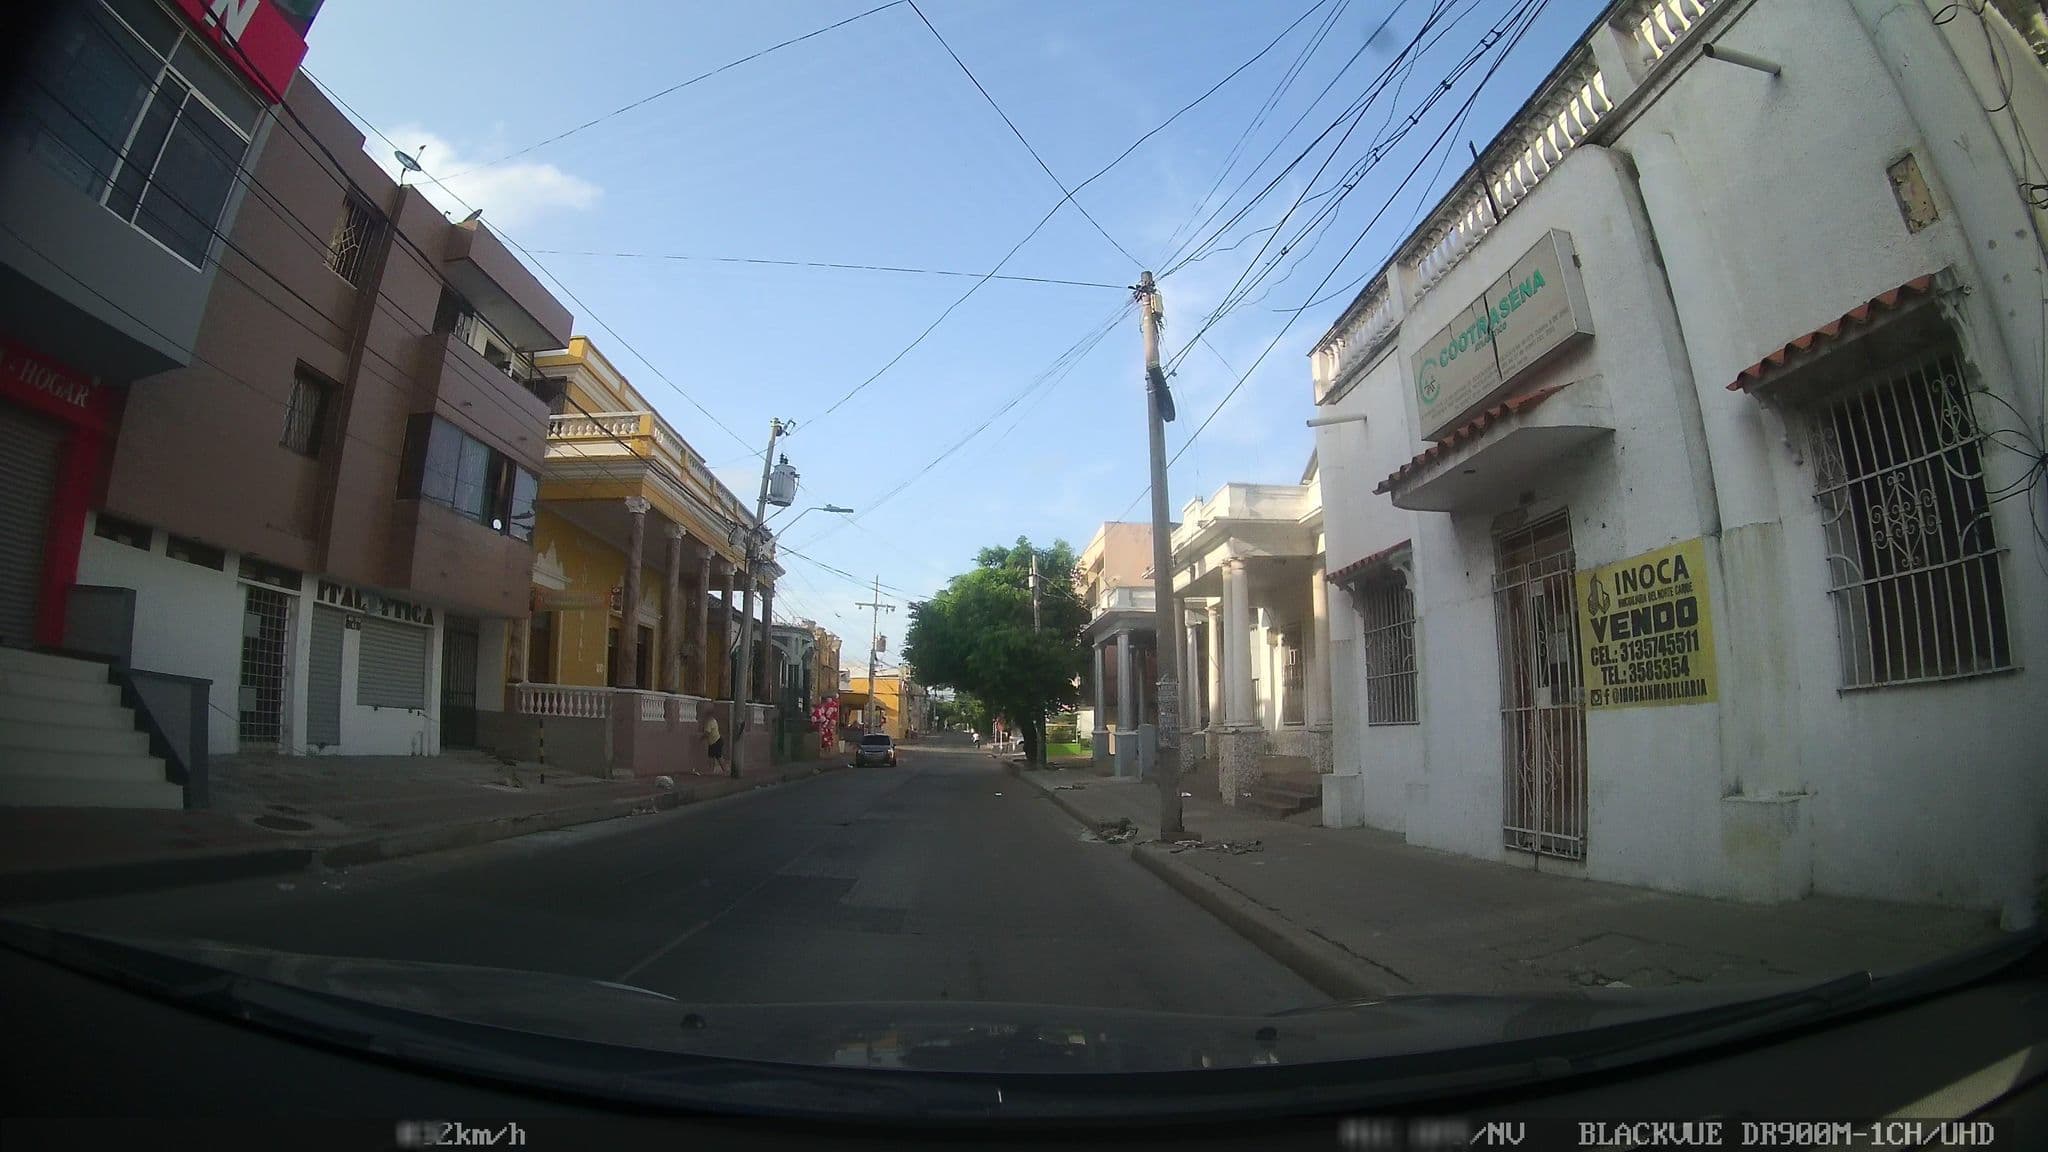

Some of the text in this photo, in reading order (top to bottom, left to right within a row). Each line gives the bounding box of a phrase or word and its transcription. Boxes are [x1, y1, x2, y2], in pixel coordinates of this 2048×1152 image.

[1440, 269, 1546, 368] COOTRASENA
[19, 359, 89, 408] HOGAR
[1614, 554, 1690, 595] INOCA
[1590, 596, 1699, 643] VENDO
[1620, 629, 1700, 662] 3135745511
